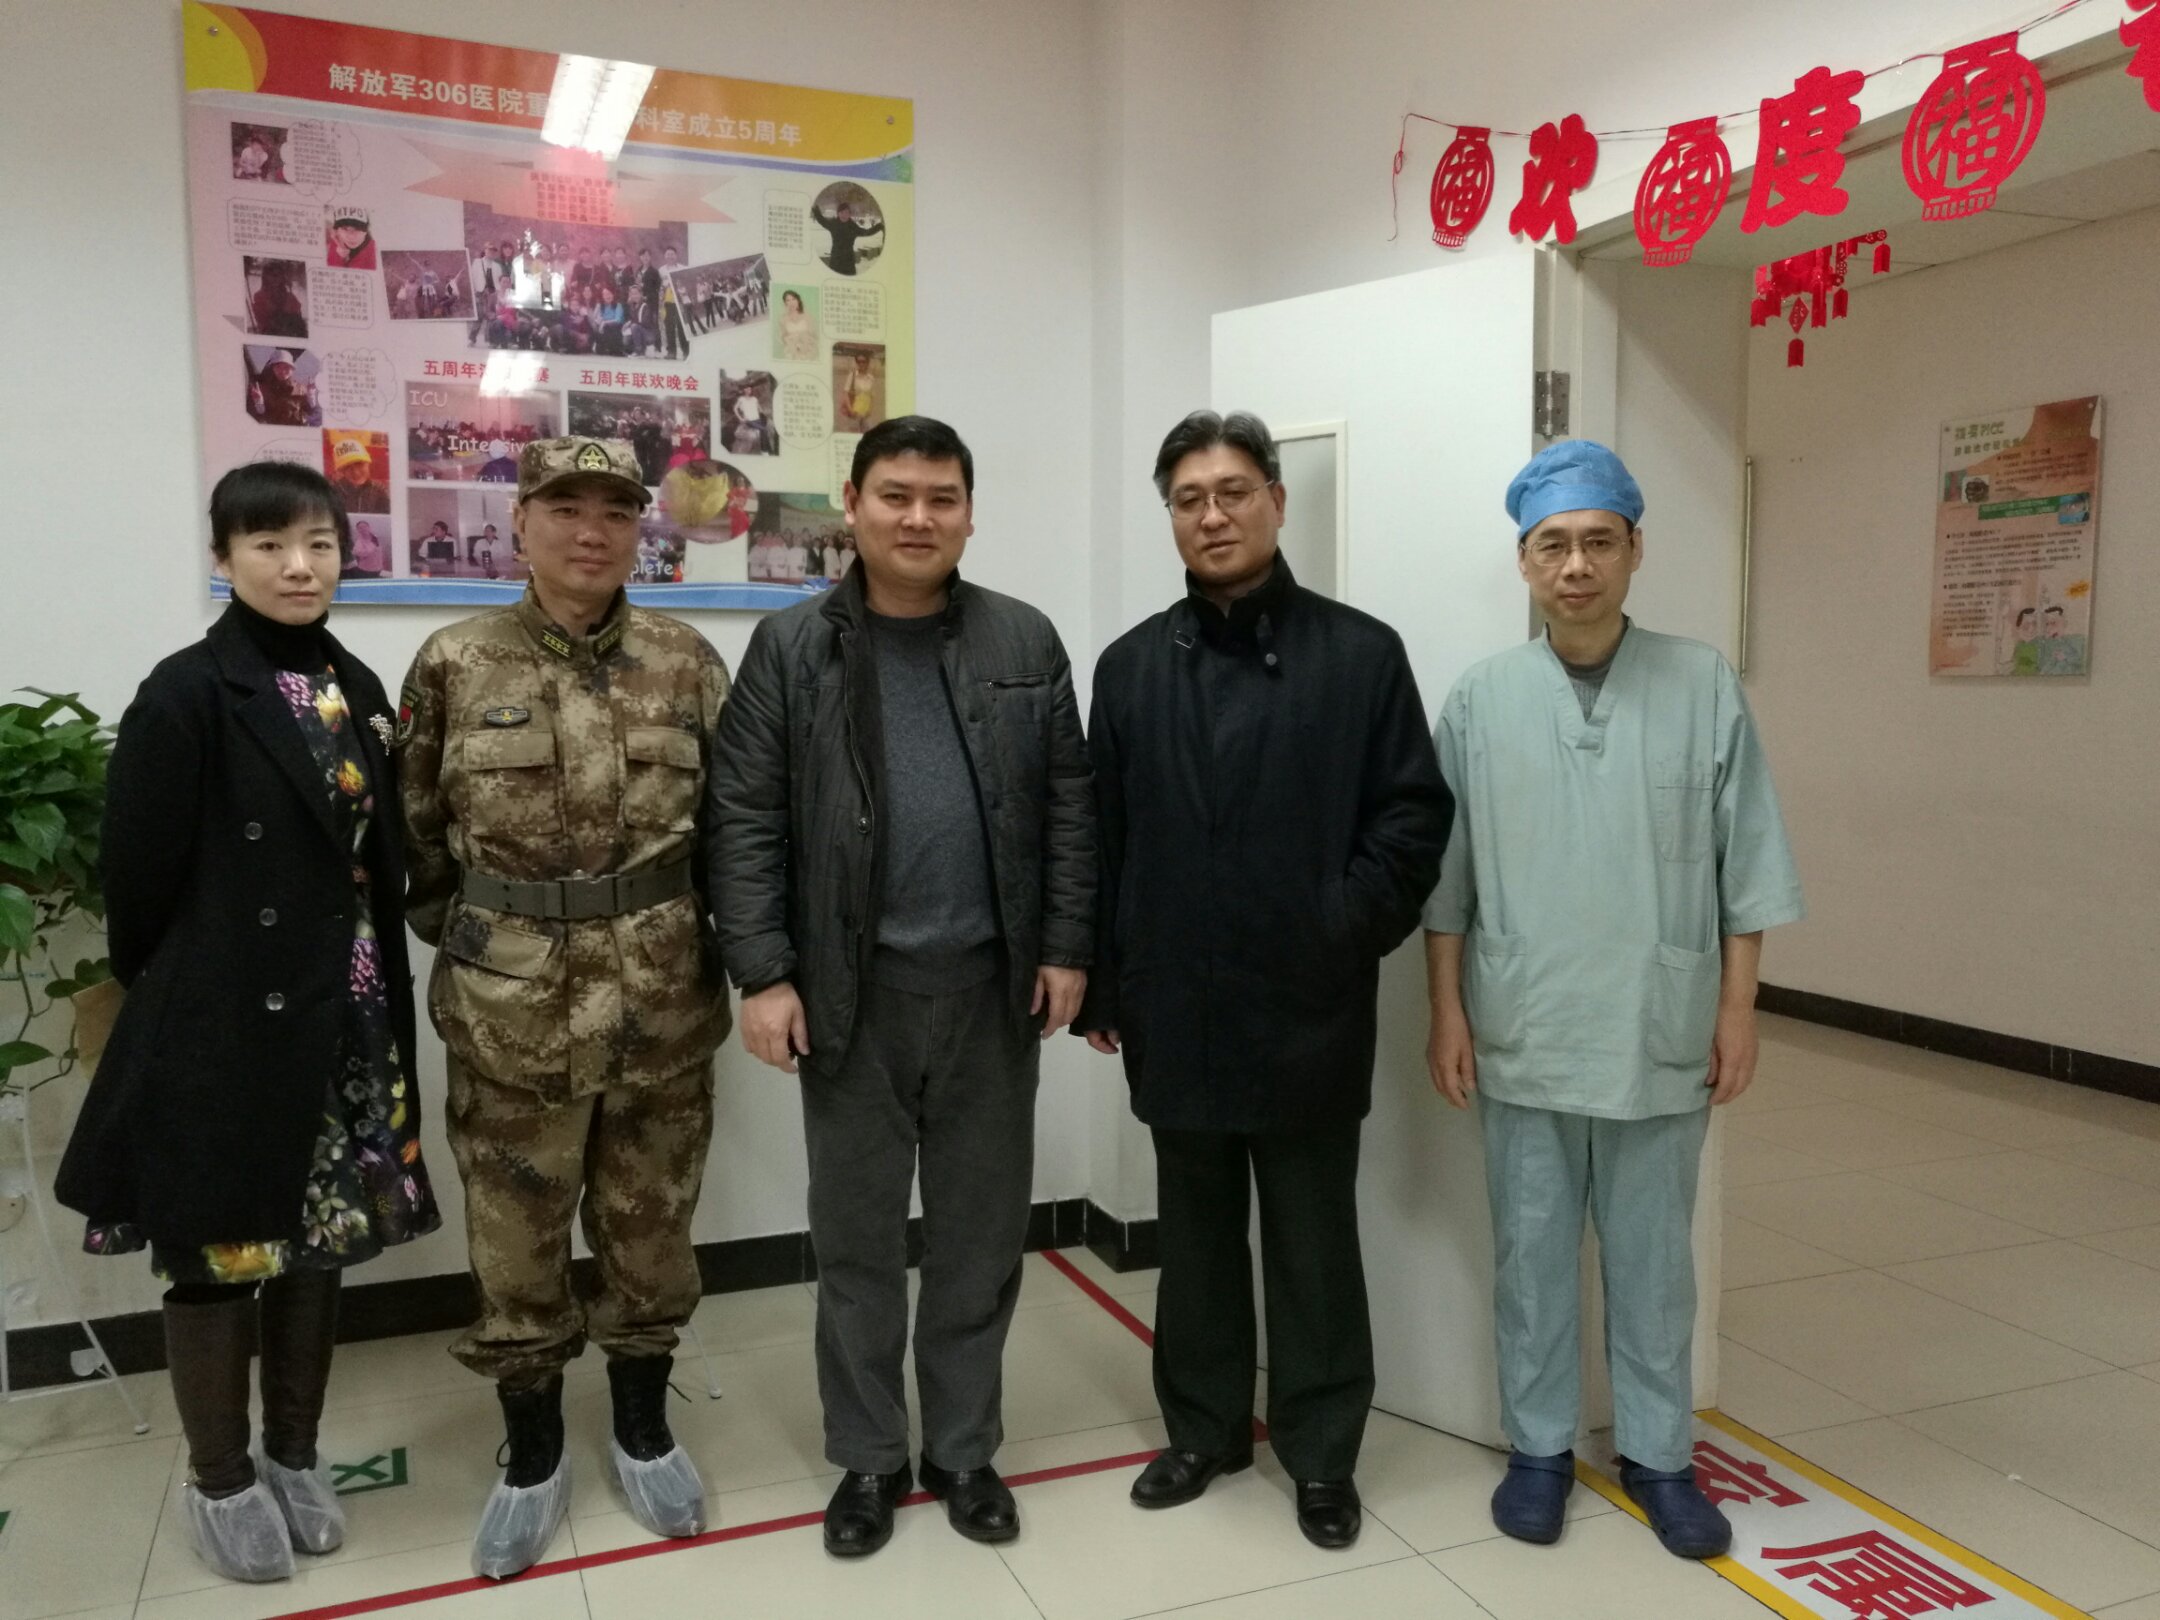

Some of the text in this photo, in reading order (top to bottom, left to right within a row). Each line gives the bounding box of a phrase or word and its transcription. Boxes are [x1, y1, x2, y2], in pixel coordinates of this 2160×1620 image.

[328, 63, 802, 147] 解放军306医院重科室成立5周年
[1509, 113, 1598, 245] 欢
[1740, 66, 1865, 234] 度
[580, 369, 699, 391] 五周年联欢晚会
[409, 389, 448, 408] ICU
[447, 435, 526, 453] Intesiv
